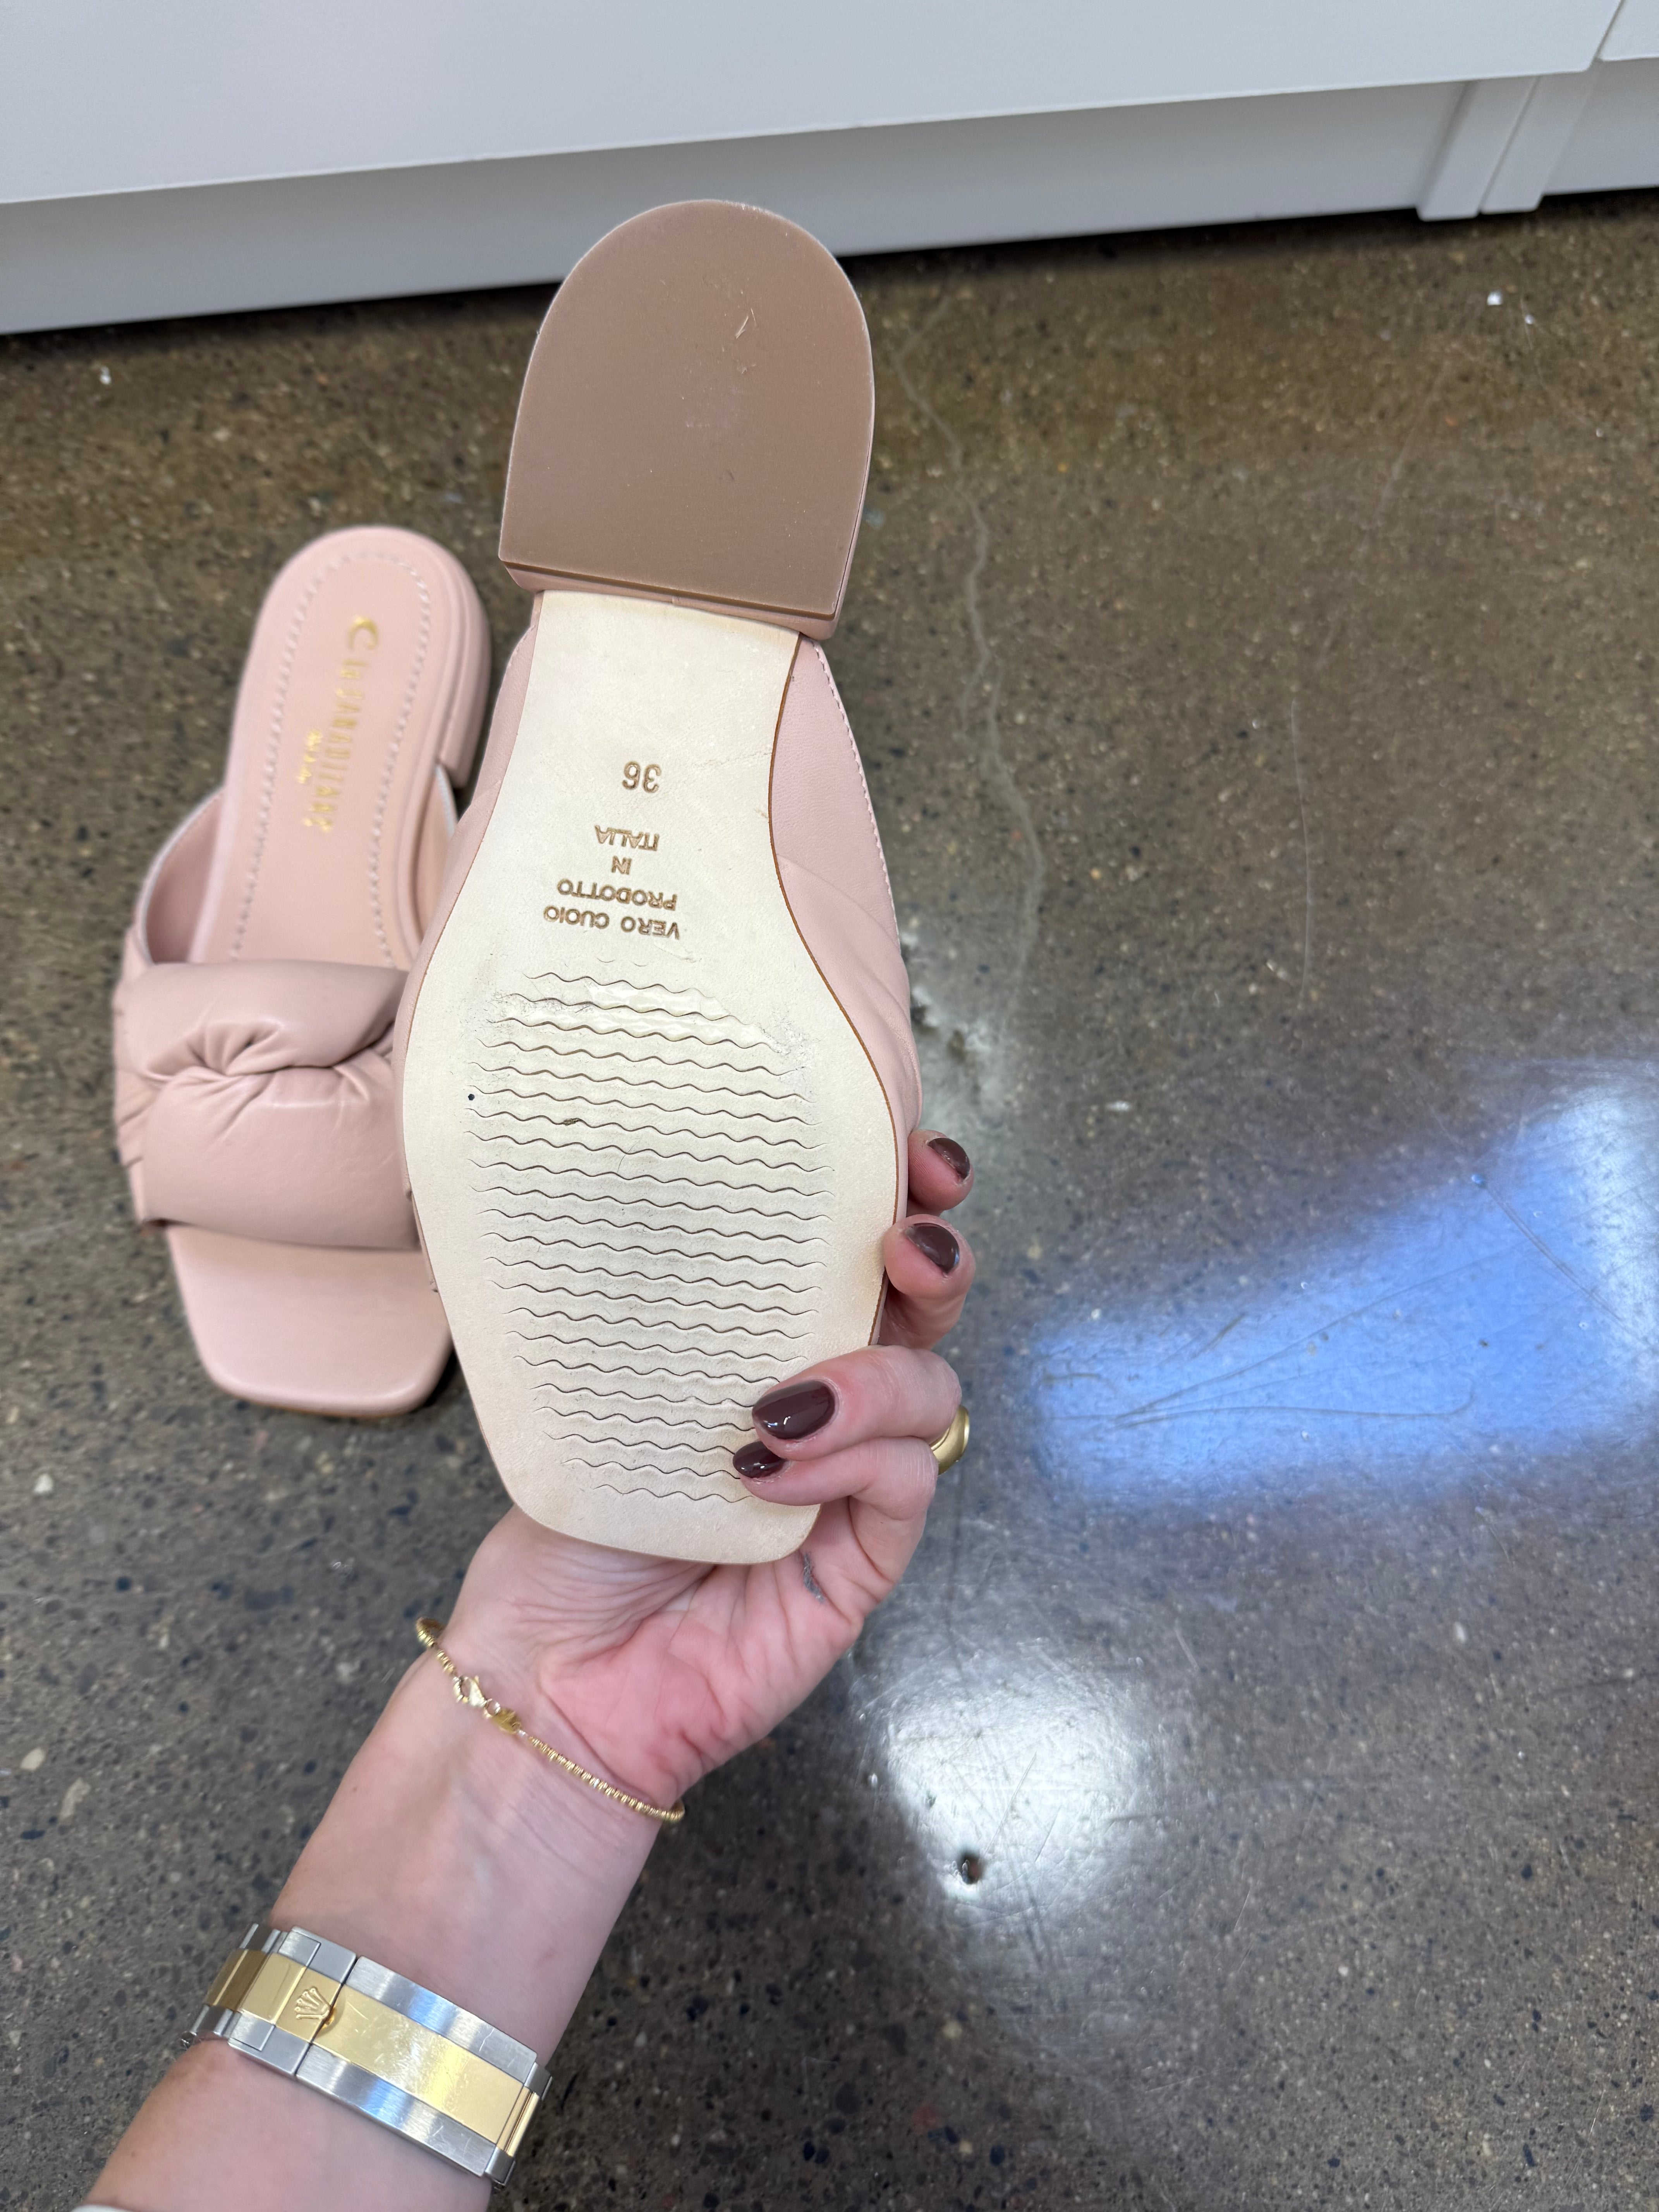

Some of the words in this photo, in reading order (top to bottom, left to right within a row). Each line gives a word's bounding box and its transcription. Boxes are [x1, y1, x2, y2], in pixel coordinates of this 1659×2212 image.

[622, 761, 662, 793] 36
[594, 825, 659, 851] ITALIA
[611, 855, 632, 875] IN
[557, 879, 677, 911] PRODOTTO
[543, 905, 610, 929] CUOIO
[620, 916, 680, 939] VERO
